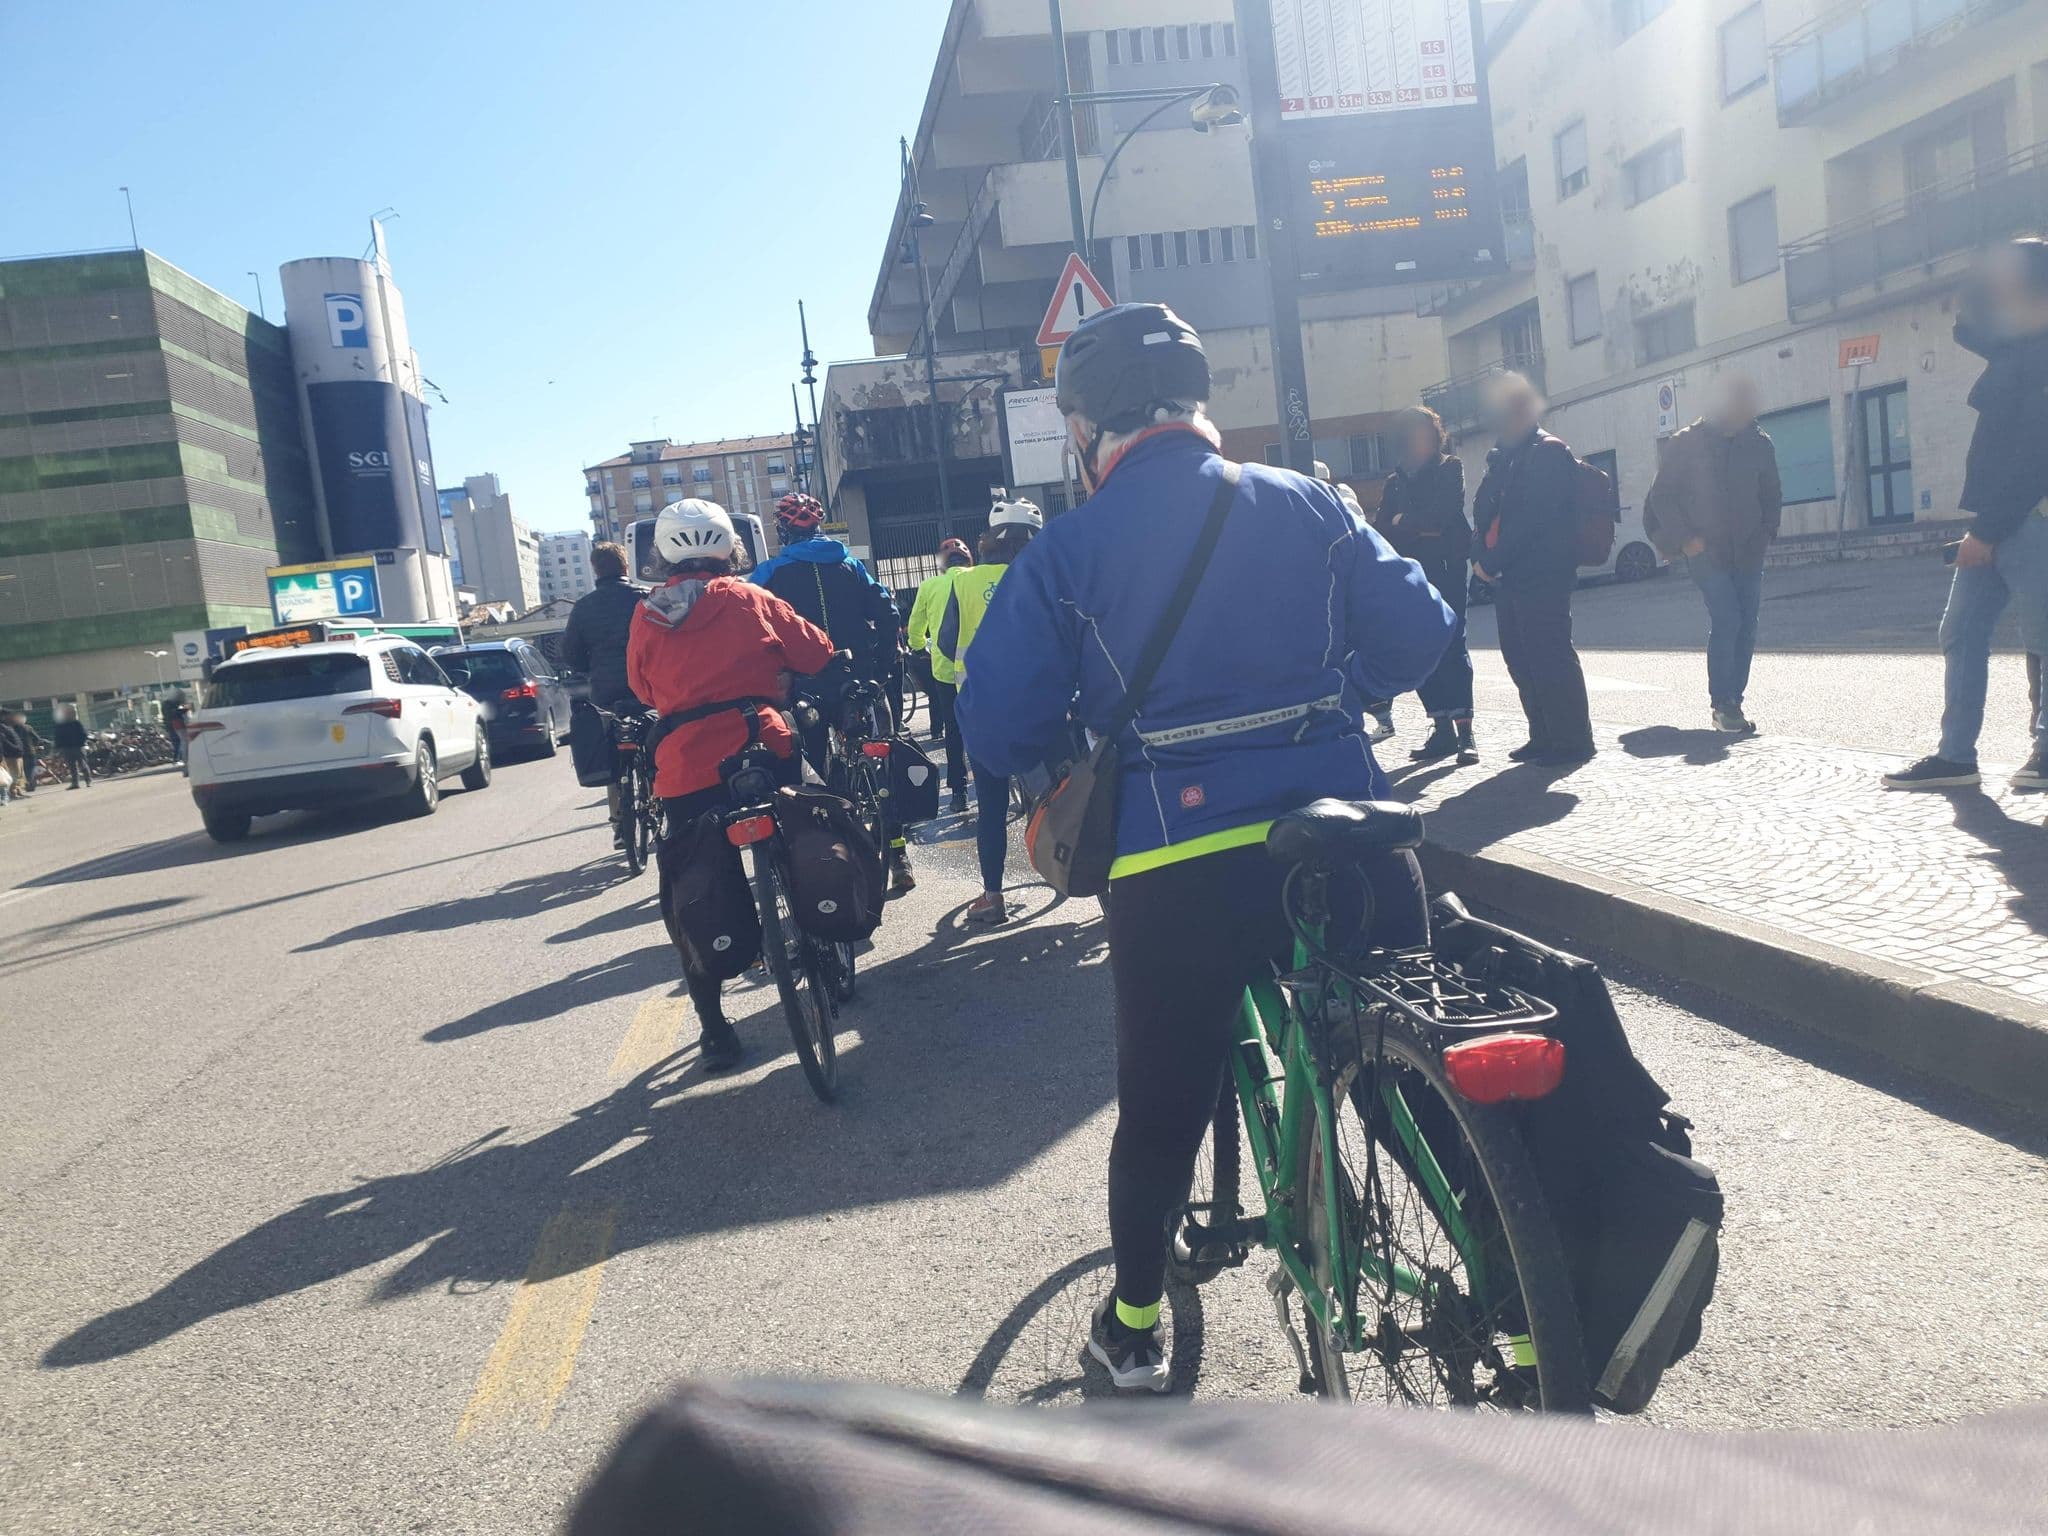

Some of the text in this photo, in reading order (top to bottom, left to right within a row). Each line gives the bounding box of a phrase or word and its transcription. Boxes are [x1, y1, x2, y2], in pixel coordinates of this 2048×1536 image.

[1427, 66, 1441, 77] 13
[1288, 99, 1296, 111] 2
[1314, 97, 1328, 109] 10
[1431, 86, 1443, 98] 16
[326, 301, 363, 347] P
[342, 580, 363, 610] P
[1215, 708, 1299, 732] Castelli
